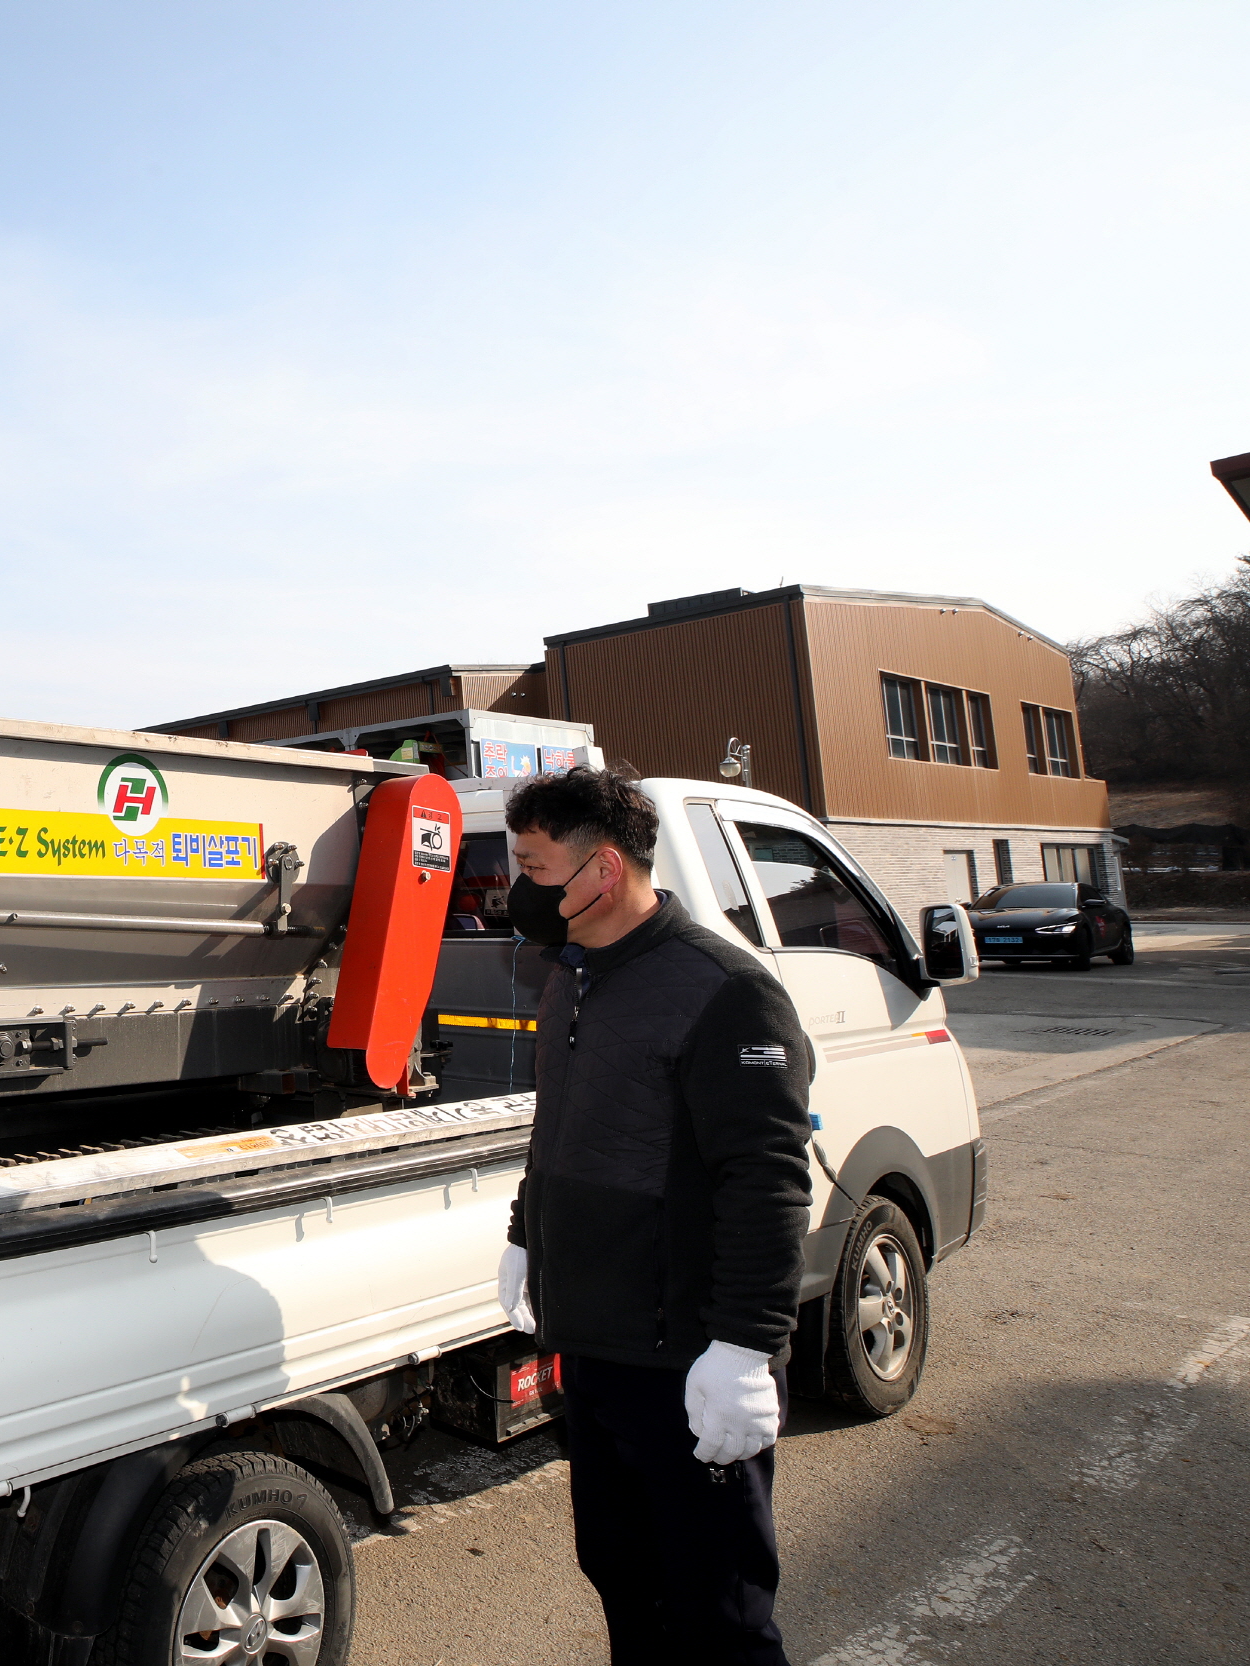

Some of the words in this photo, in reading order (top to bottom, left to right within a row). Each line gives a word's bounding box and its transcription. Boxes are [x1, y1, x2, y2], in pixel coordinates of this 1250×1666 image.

[483, 742, 508, 764] 추락
[36, 827, 106, 866] System
[113, 838, 166, 866] 다목적
[171, 833, 258, 869] 퇴비살포기
[851, 1220, 873, 1271] KUMHO
[517, 1366, 553, 1392] ROCKET
[224, 1488, 293, 1520] KUMHO
